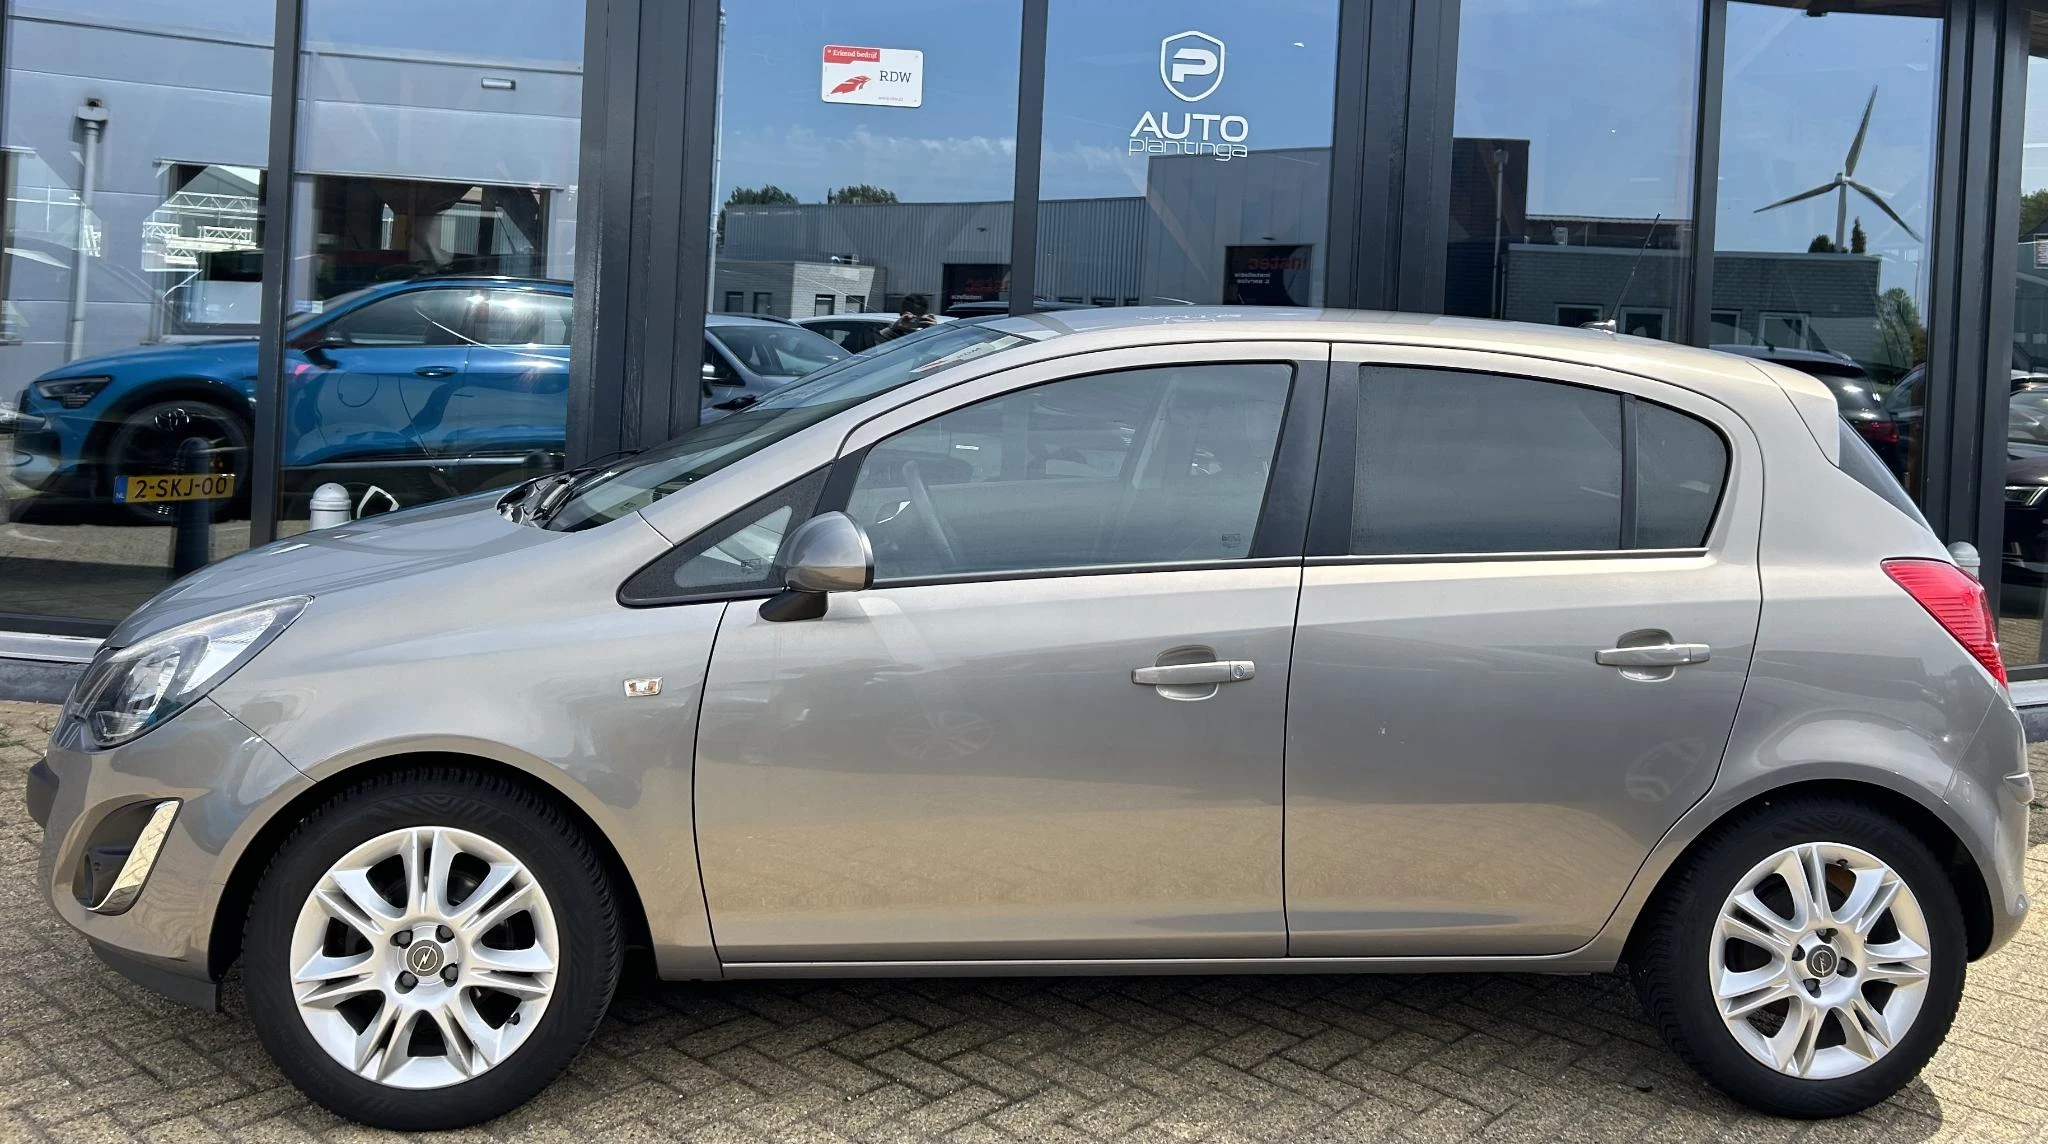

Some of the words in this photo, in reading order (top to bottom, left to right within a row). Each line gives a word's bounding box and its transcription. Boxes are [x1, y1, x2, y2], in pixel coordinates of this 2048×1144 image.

[879, 70, 912, 83] RDW
[1172, 48, 1218, 82] P
[1130, 110, 1249, 142] AUTO
[1128, 136, 1248, 162] plantinga
[134, 477, 228, 499] 2-SKJ-00
